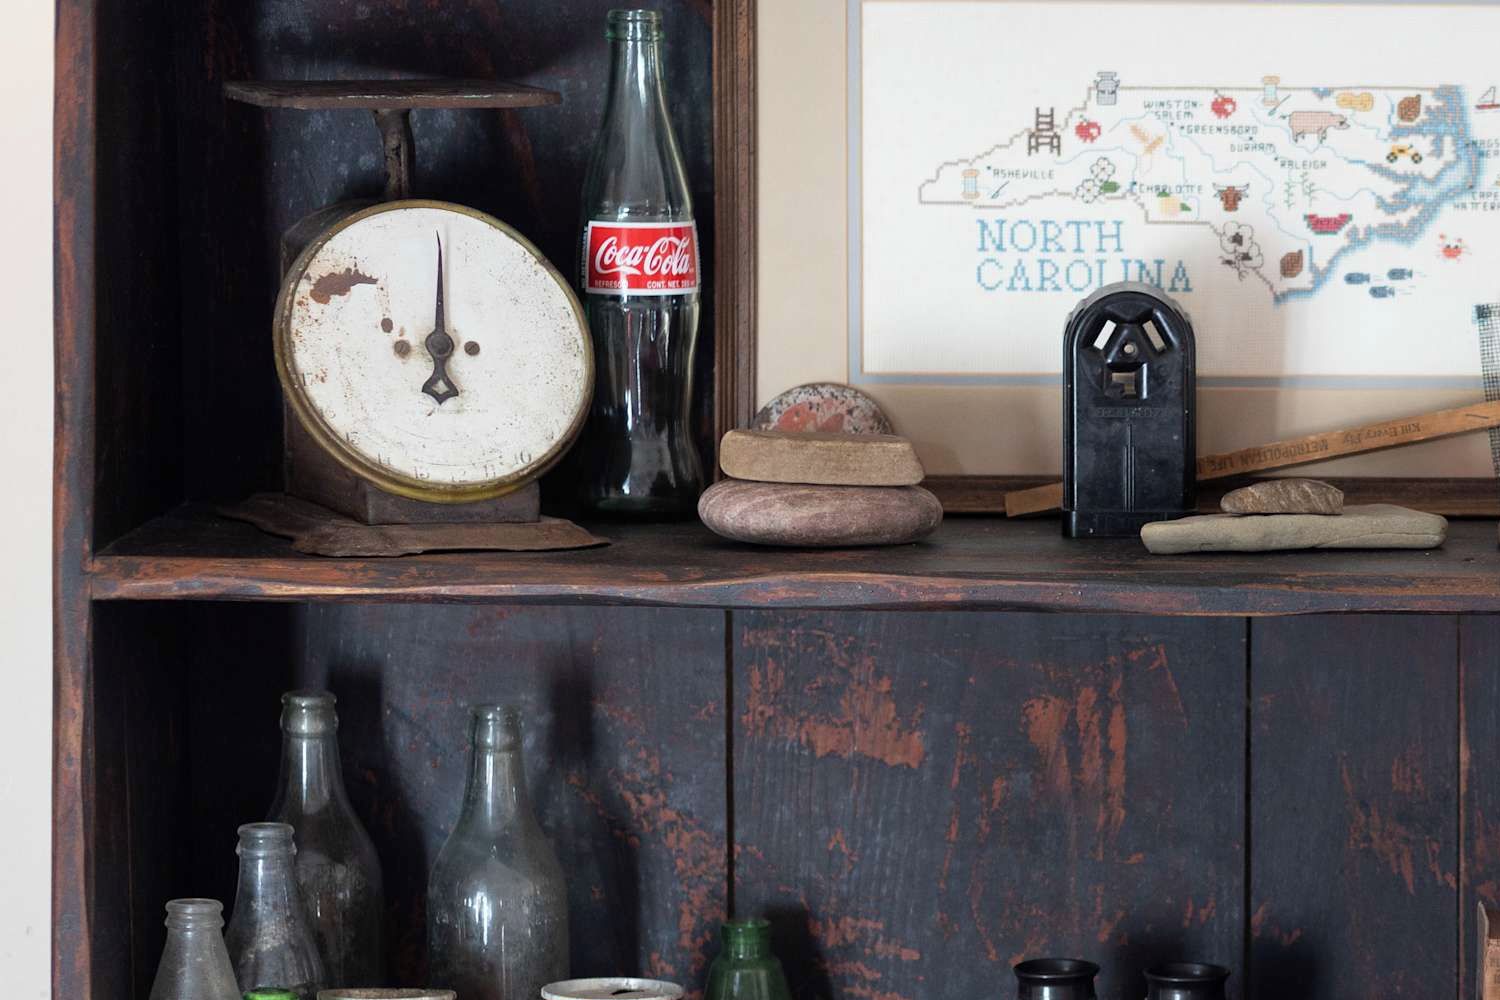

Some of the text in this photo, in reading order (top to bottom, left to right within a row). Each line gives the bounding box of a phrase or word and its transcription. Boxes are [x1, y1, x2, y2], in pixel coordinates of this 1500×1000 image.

[1154, 111, 1194, 120] SALEM
[1230, 143, 1276, 153] DURHAM
[1280, 160, 1327, 169] RALEIGH
[993, 169, 1055, 180] ASHEVILLE
[1139, 184, 1204, 195] CHARLOTTE
[976, 219, 1124, 253] NORTH
[594, 236, 691, 276] Coca-Cola
